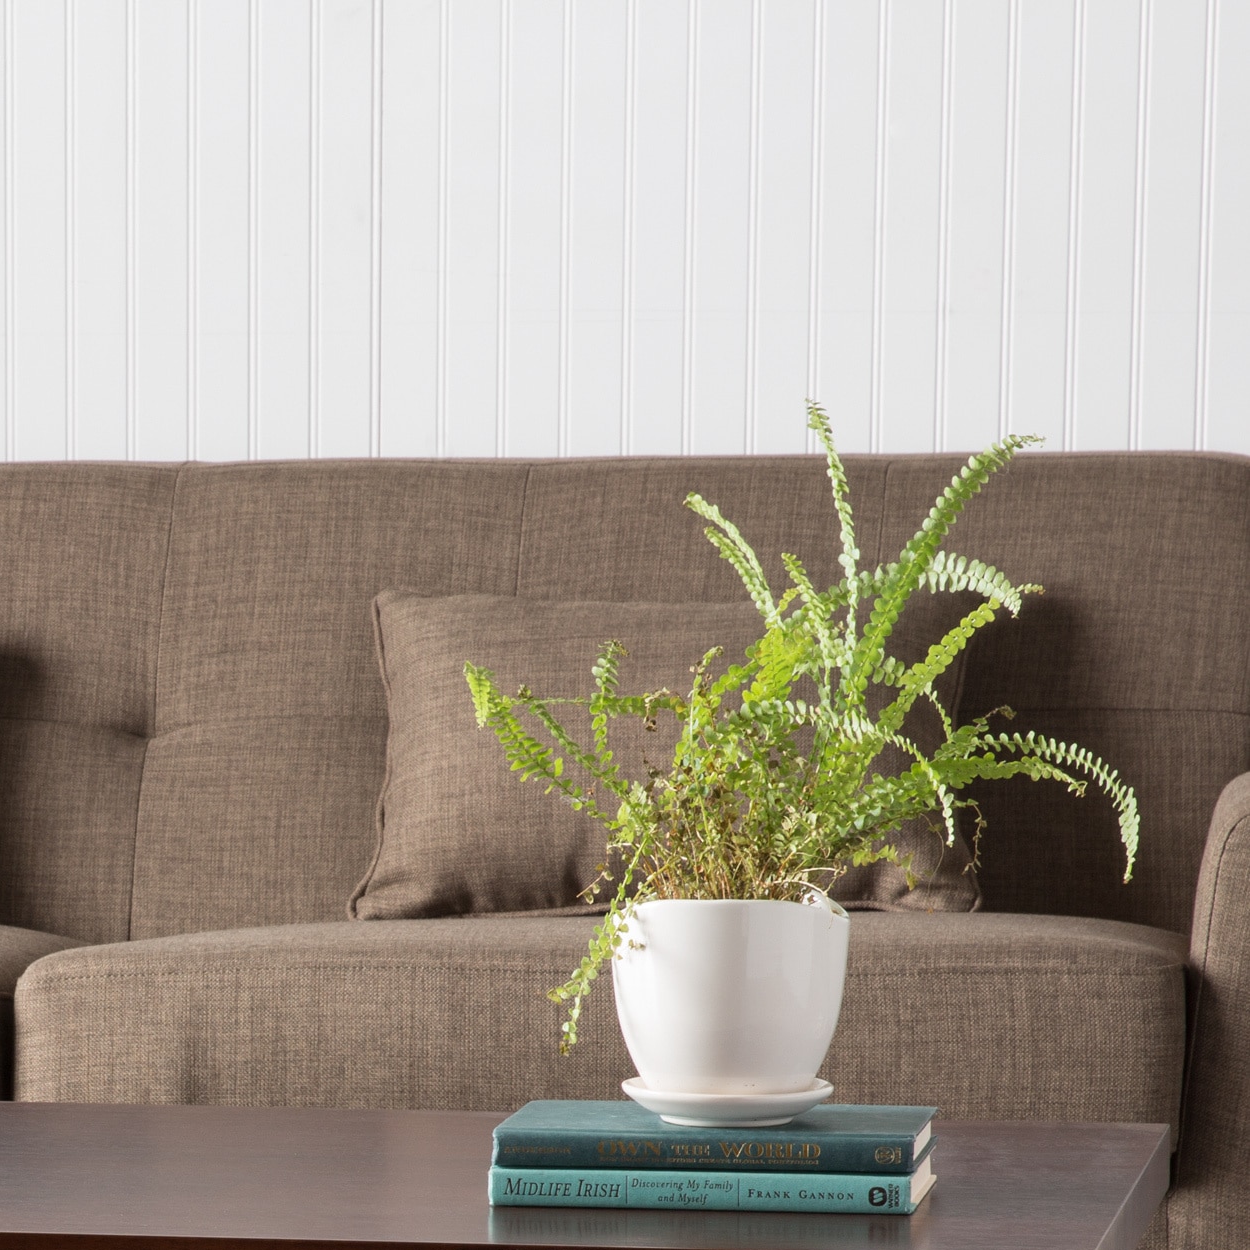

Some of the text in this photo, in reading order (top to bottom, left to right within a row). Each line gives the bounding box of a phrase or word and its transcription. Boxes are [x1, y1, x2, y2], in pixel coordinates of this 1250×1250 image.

[597, 1141, 821, 1159] OWN THE WORLD
[503, 1177, 622, 1198] MIDLIFE IRISH
[631, 1178, 734, 1191] Discovering My Family
[657, 1193, 709, 1206] and Myself
[747, 1188, 855, 1201] FRANK GANNON
